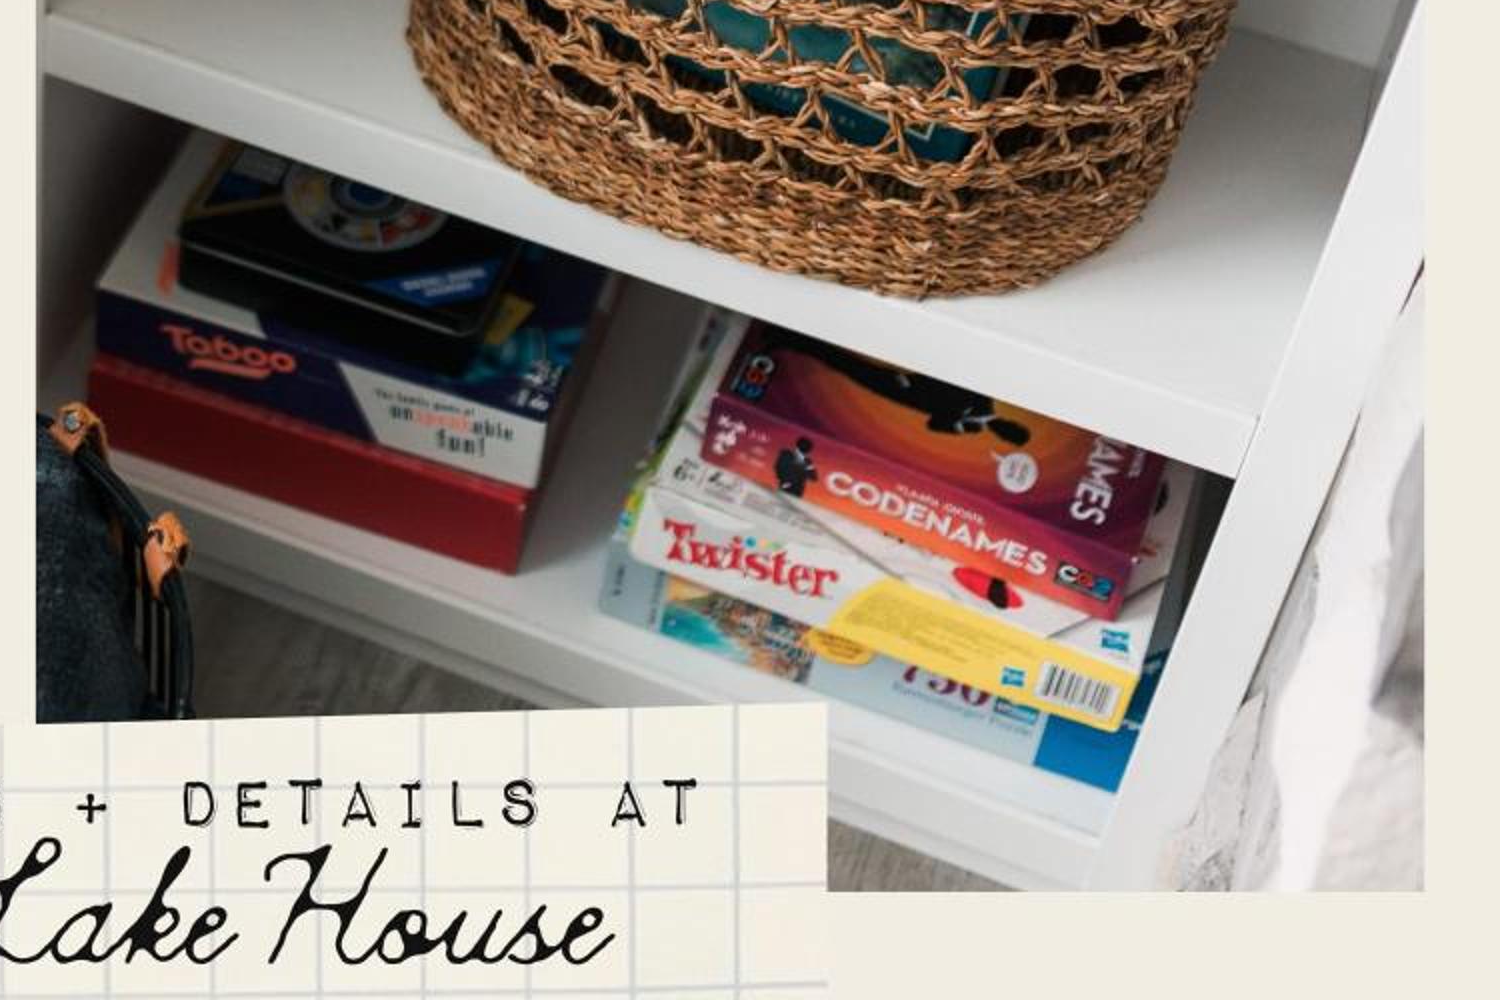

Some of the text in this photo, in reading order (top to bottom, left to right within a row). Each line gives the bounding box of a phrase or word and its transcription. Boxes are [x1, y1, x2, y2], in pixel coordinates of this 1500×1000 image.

[160, 323, 297, 374] Taboo
[436, 427, 486, 457] fun!
[825, 470, 1048, 576] CODENAMES
[663, 518, 839, 597] Twister
